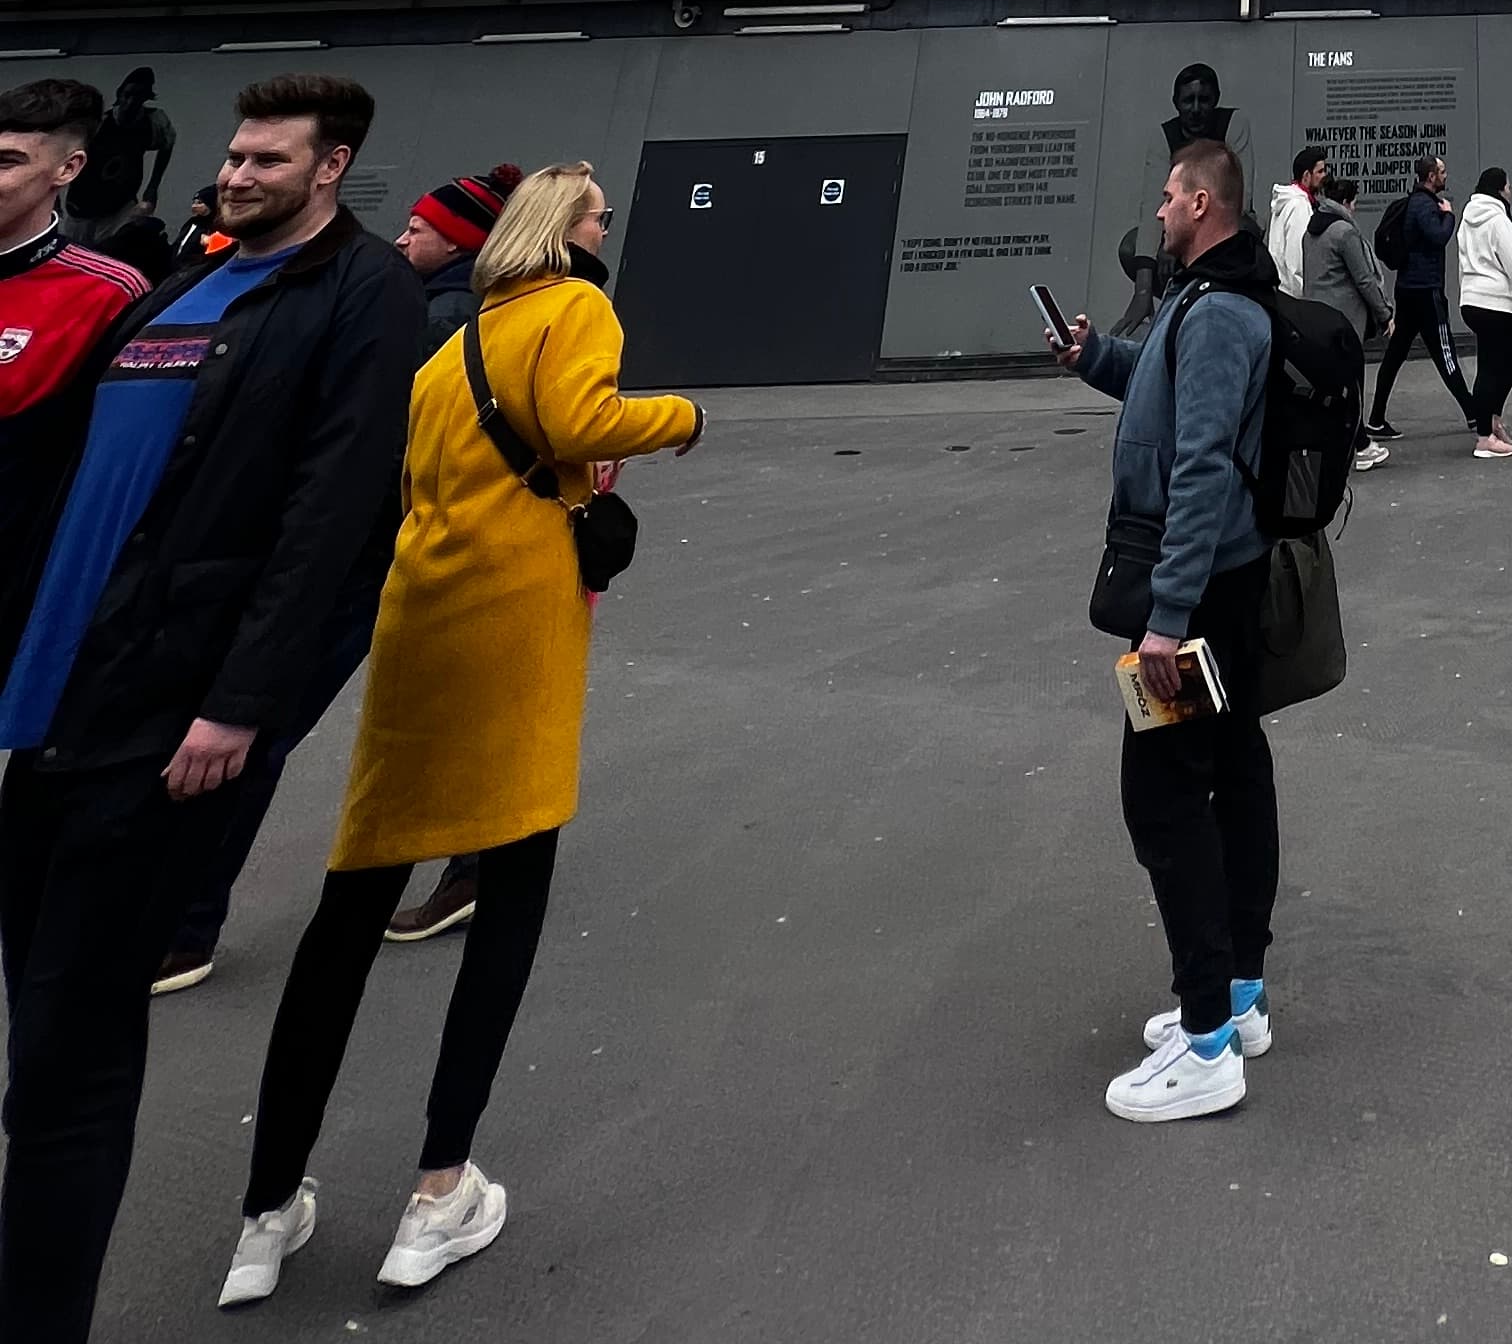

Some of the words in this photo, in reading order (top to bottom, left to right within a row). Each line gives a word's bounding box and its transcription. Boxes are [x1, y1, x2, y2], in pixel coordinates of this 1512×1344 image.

[1307, 53, 1325, 67] THE
[1328, 52, 1353, 67] FANS
[975, 91, 1004, 107] JOHN
[1006, 90, 1055, 106] RADFORD
[1305, 126, 1356, 142] WHATEVER
[1359, 125, 1377, 141] THE
[1380, 124, 1417, 140] SEASON
[1420, 123, 1447, 139] JOHN
[754, 150, 767, 165] 15
[1340, 144, 1360, 159] FEEL
[1364, 144, 1373, 158] IT
[1376, 141, 1431, 158] NECESSARY
[1435, 140, 1447, 156] TO
[1340, 162, 1360, 177] FOR
[1362, 161, 1370, 176] A
[1372, 159, 1412, 175] JUMPER
